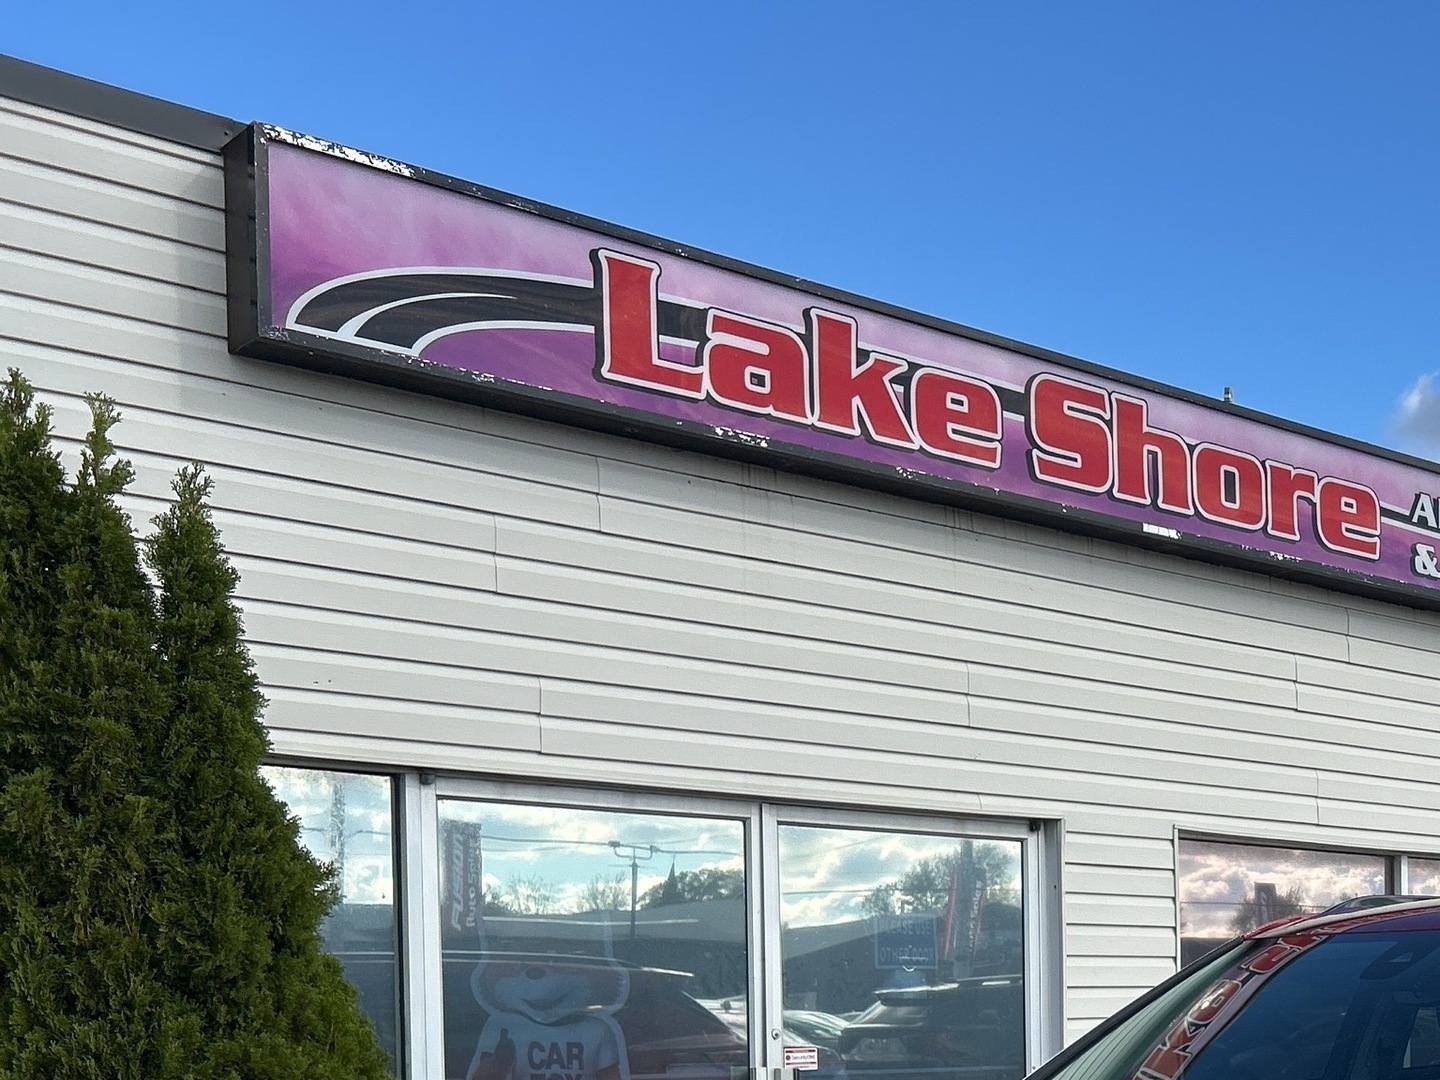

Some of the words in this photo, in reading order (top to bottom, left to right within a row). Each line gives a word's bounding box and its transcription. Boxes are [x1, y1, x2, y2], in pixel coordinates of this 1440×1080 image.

[598, 247, 1003, 470] Lake
[1029, 371, 1382, 560] Shore
[1414, 543, 1440, 579] &
[879, 919, 914, 935] PLEASE
[915, 919, 931, 935] USE
[880, 947, 910, 963] OTHER
[912, 947, 935, 963] DOOR
[528, 1041, 584, 1070] CAR
